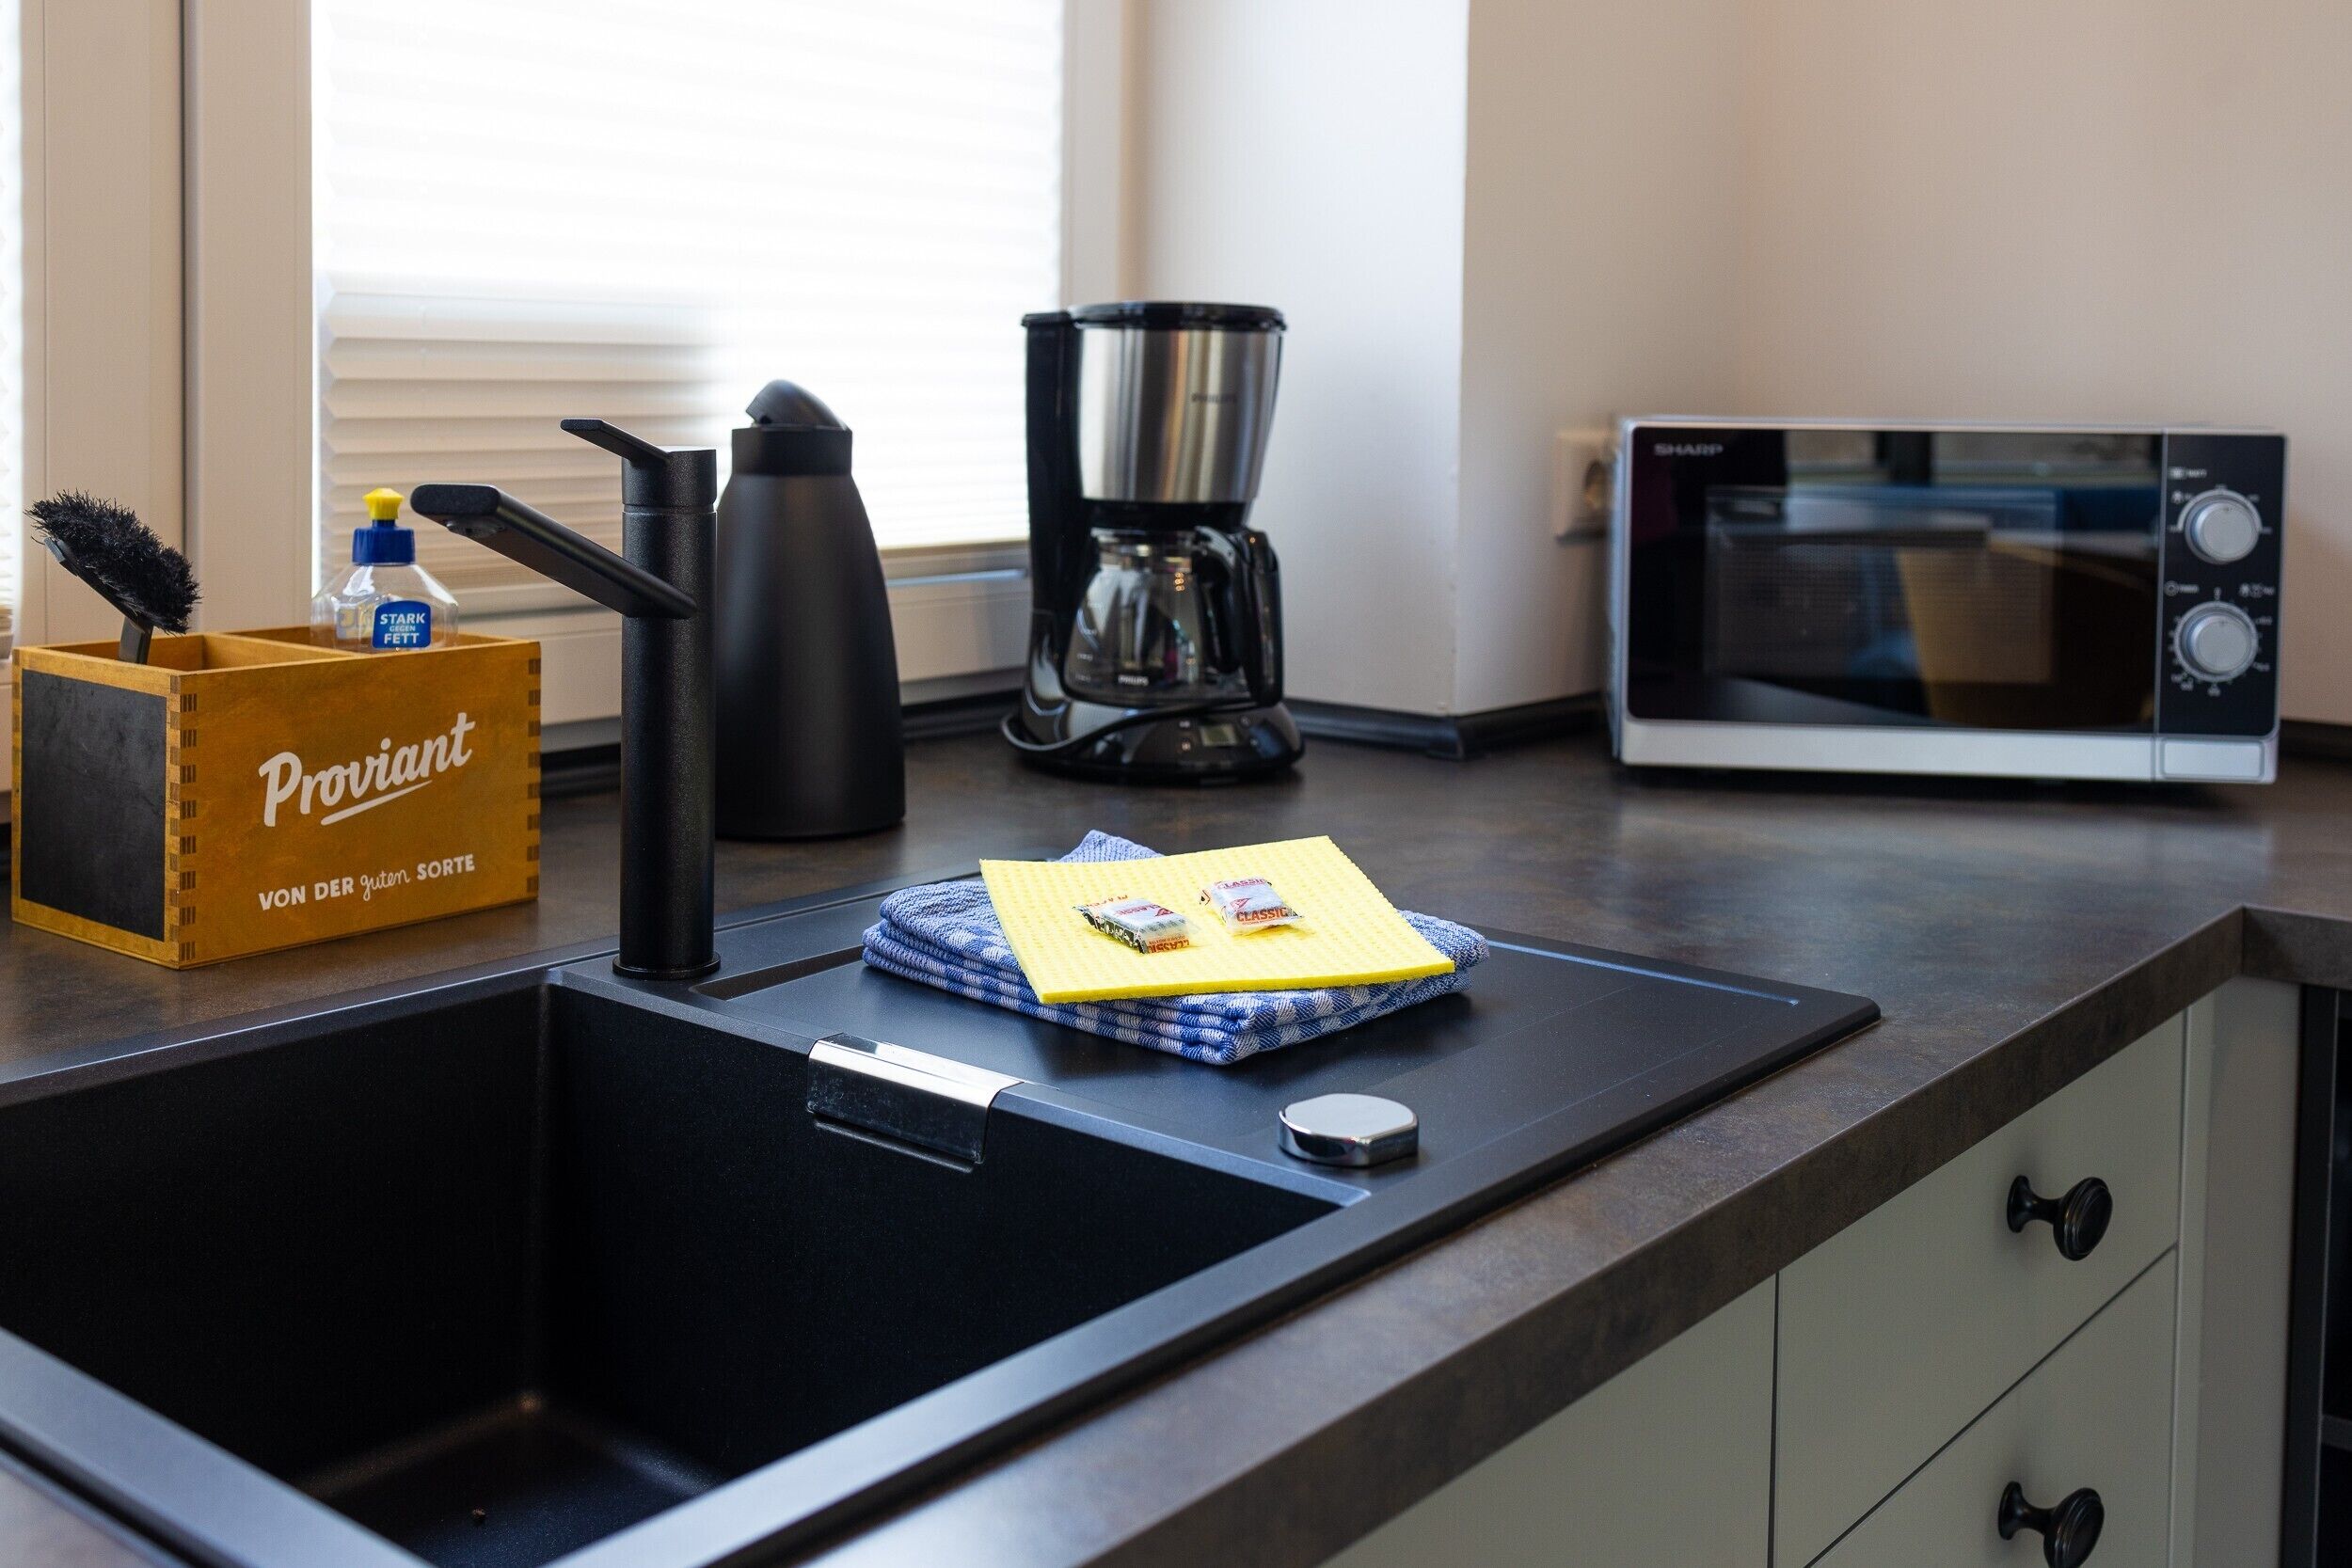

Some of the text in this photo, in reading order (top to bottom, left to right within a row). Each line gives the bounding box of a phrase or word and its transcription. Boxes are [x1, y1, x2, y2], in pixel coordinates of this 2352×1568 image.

[1654, 442, 1724, 456] SHARP
[380, 612, 425, 625] STARK
[384, 632, 419, 644] FETT
[258, 712, 475, 827] Proviant
[258, 854, 475, 911] VON DER guten SORTE
[1236, 907, 1289, 923] CLASSIC
